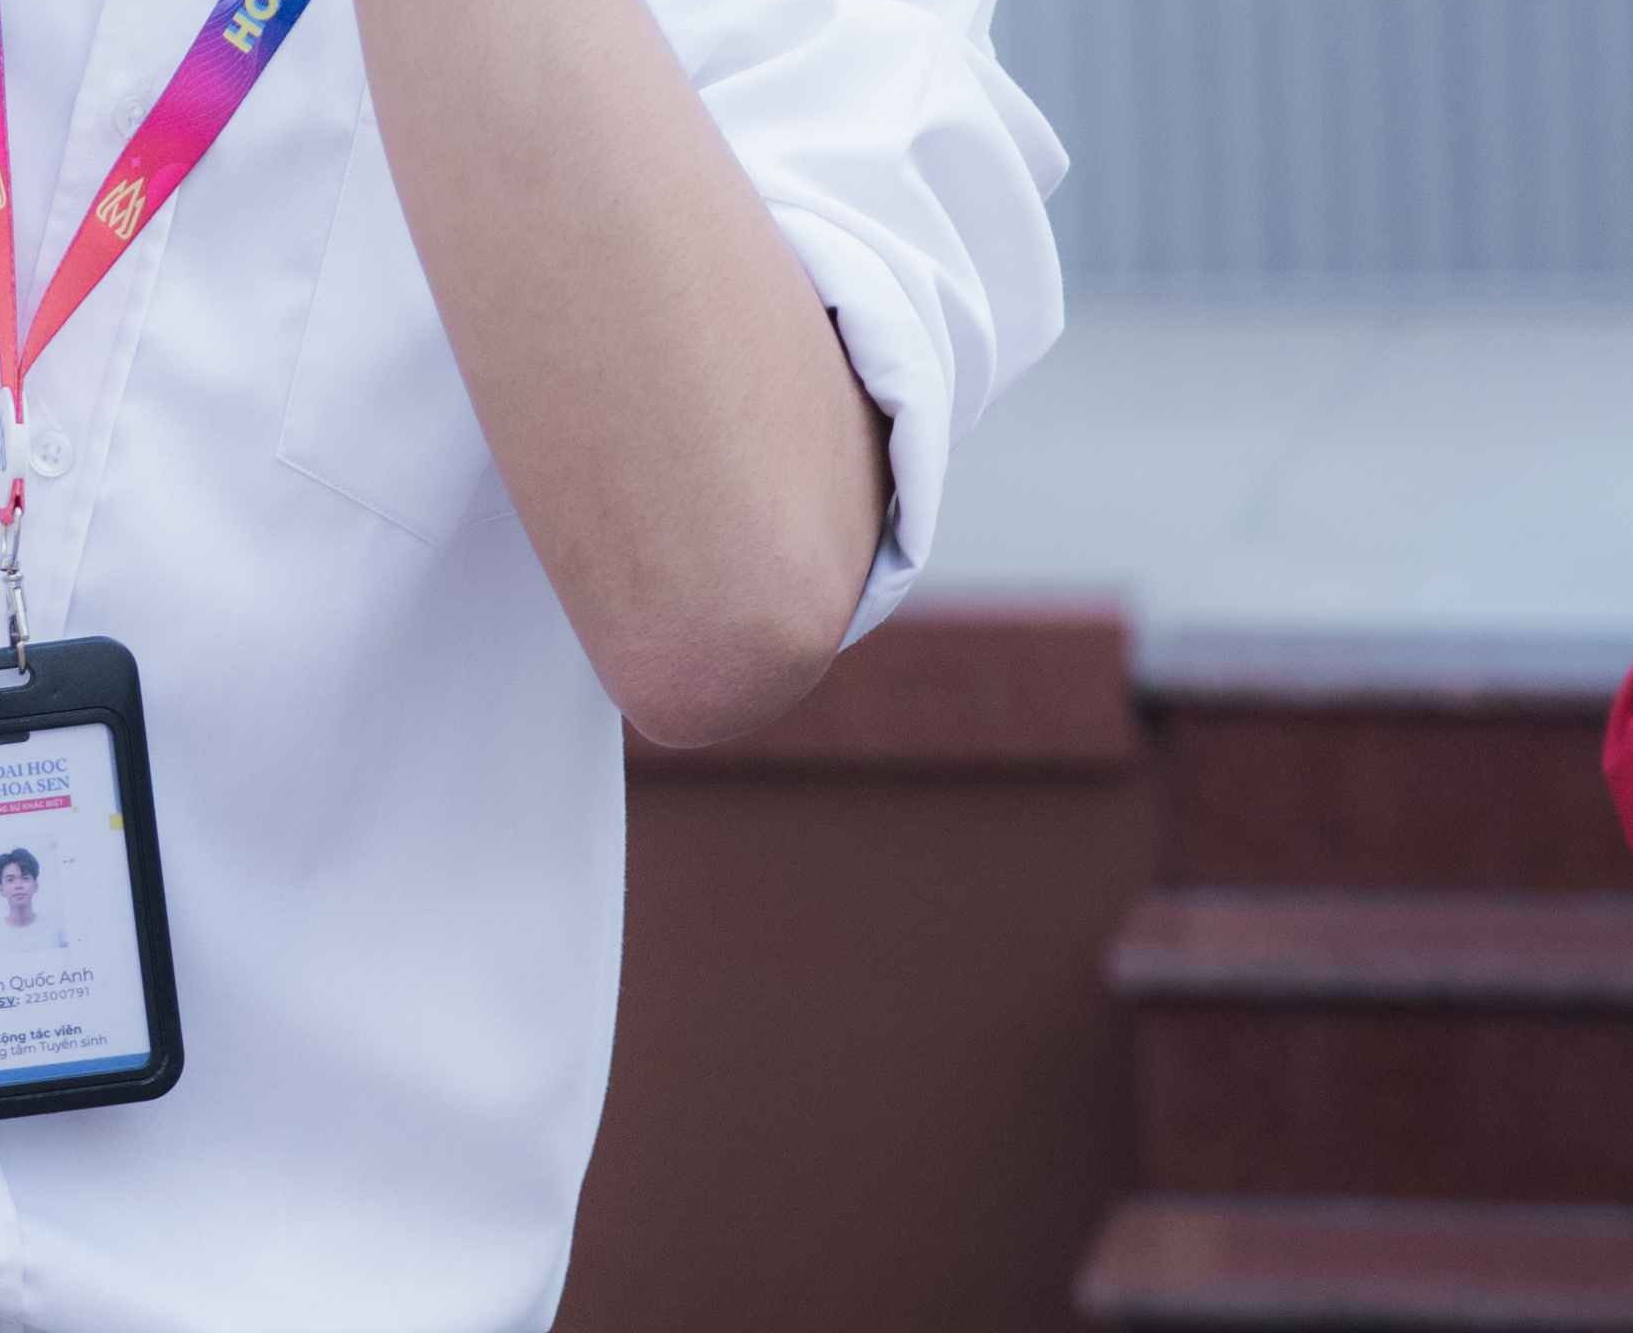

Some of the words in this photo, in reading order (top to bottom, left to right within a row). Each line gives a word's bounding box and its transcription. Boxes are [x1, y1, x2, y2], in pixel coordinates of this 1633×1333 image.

[37, 775, 70, 793] SEN
[9, 971, 55, 991] Quốc
[59, 967, 94, 984] Anh
[30, 1028, 51, 1040] tác
[54, 1024, 83, 1036] viên
[80, 1034, 108, 1047] sinh
